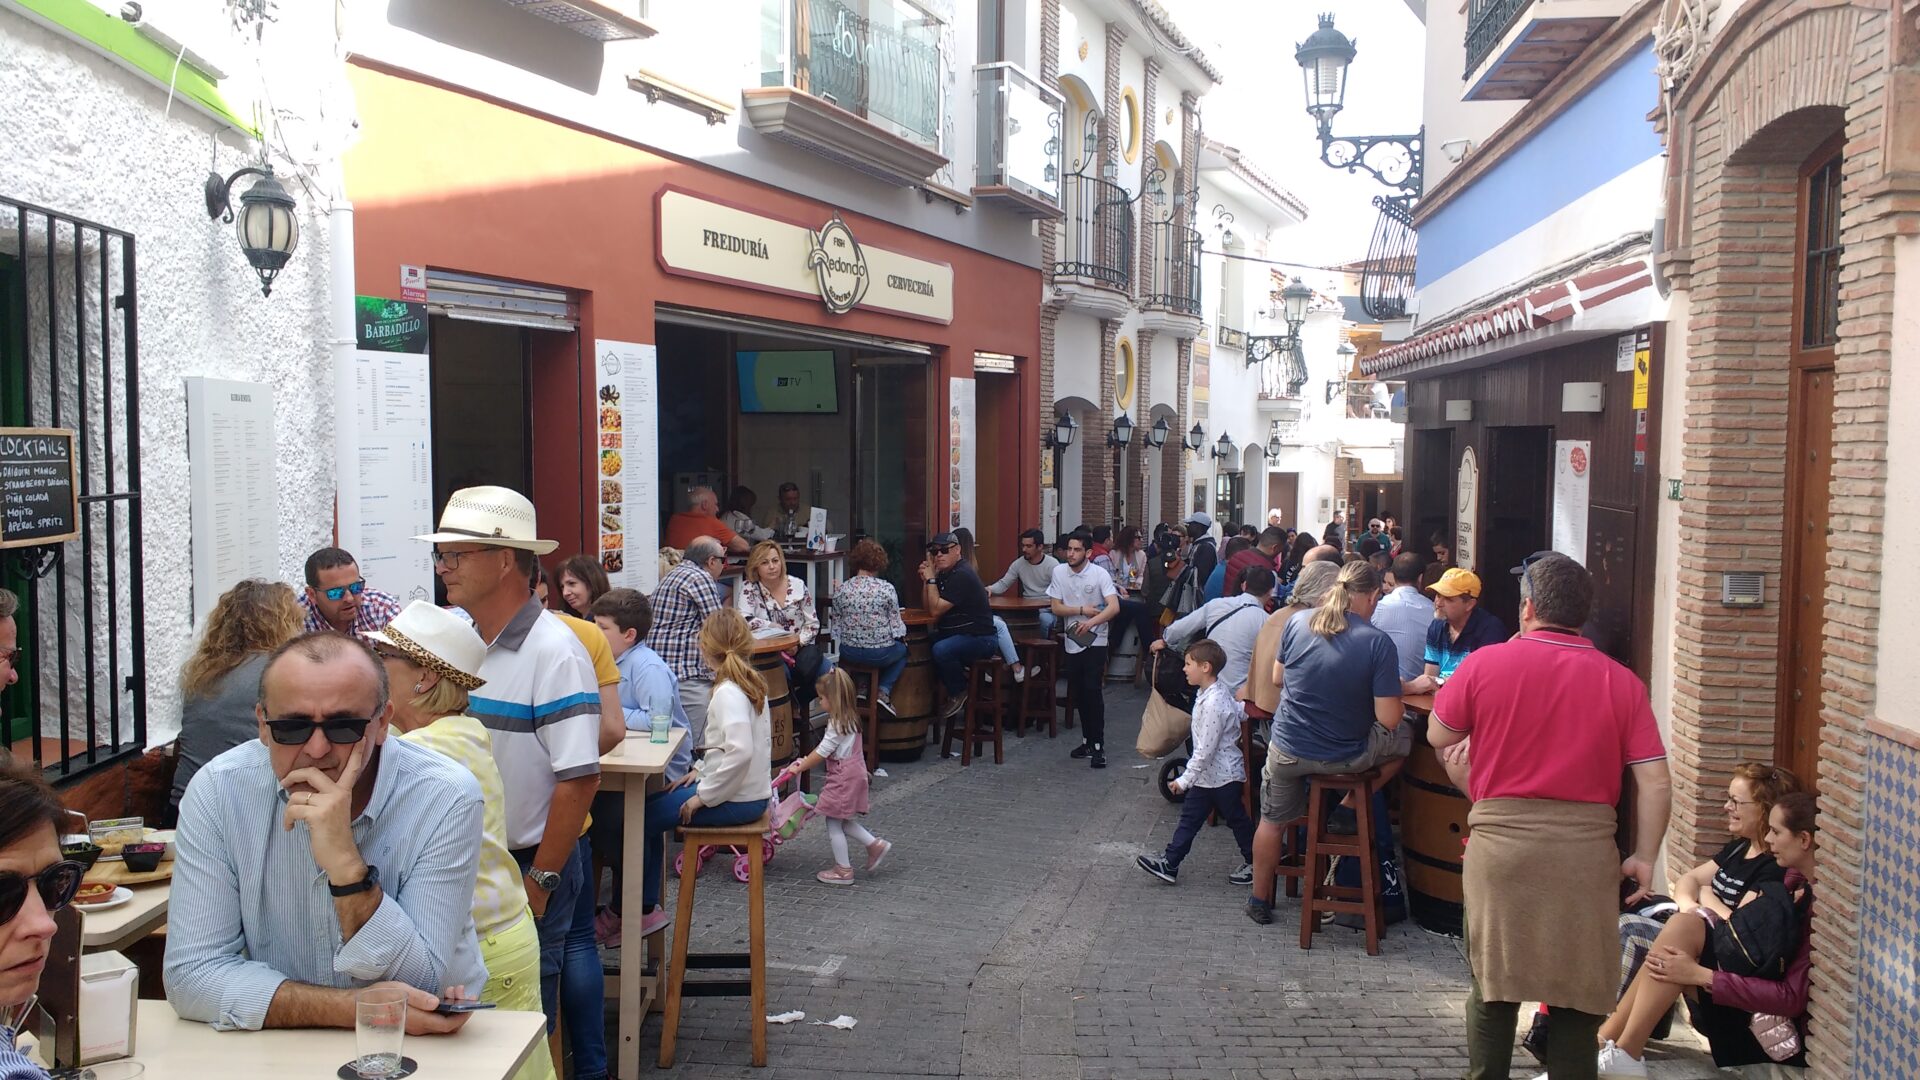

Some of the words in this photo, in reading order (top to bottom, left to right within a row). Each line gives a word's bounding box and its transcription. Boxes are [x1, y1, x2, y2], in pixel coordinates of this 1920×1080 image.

[703, 229, 769, 259] FREIDURÍA
[833, 237, 846, 248] FISH
[887, 274, 934, 297] CERVECERÍA
[402, 288, 425, 298] Alarma
[365, 318, 420, 338] BARBADILLO
[4, 479, 46, 490] STRAWBERRY
[25, 491, 49, 502] COLADA
[8, 521, 35, 533] APEROL
